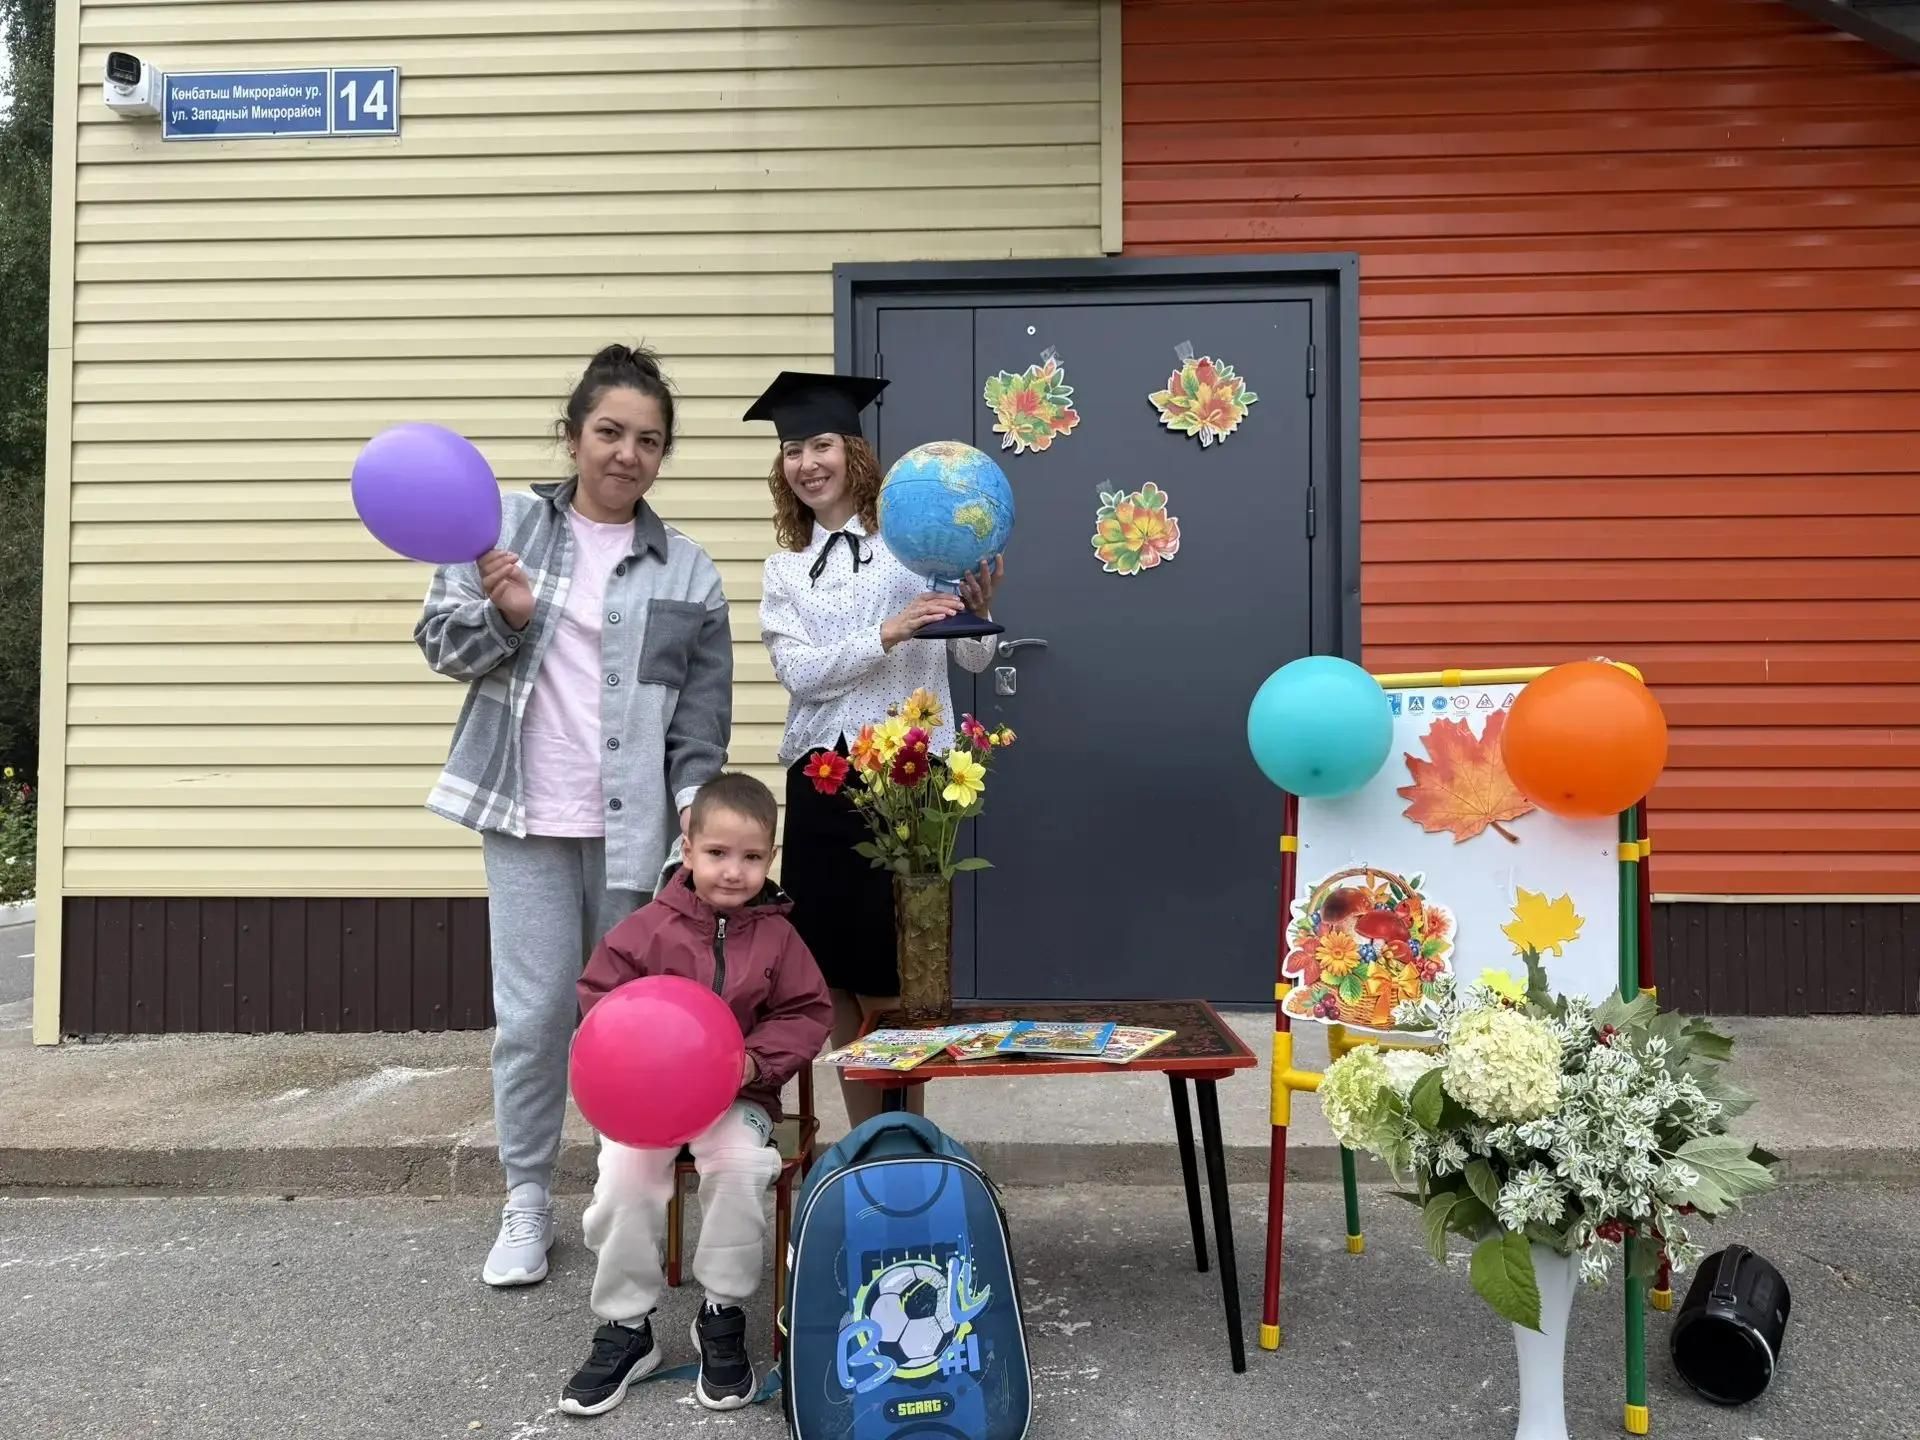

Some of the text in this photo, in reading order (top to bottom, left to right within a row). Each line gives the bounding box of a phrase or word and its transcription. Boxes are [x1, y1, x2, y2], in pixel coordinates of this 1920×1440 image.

[171, 84, 322, 100] Көнбатыш Микрорайон ур.
[339, 79, 388, 121] 14
[171, 104, 322, 124] ул. Западный Микрорайон
